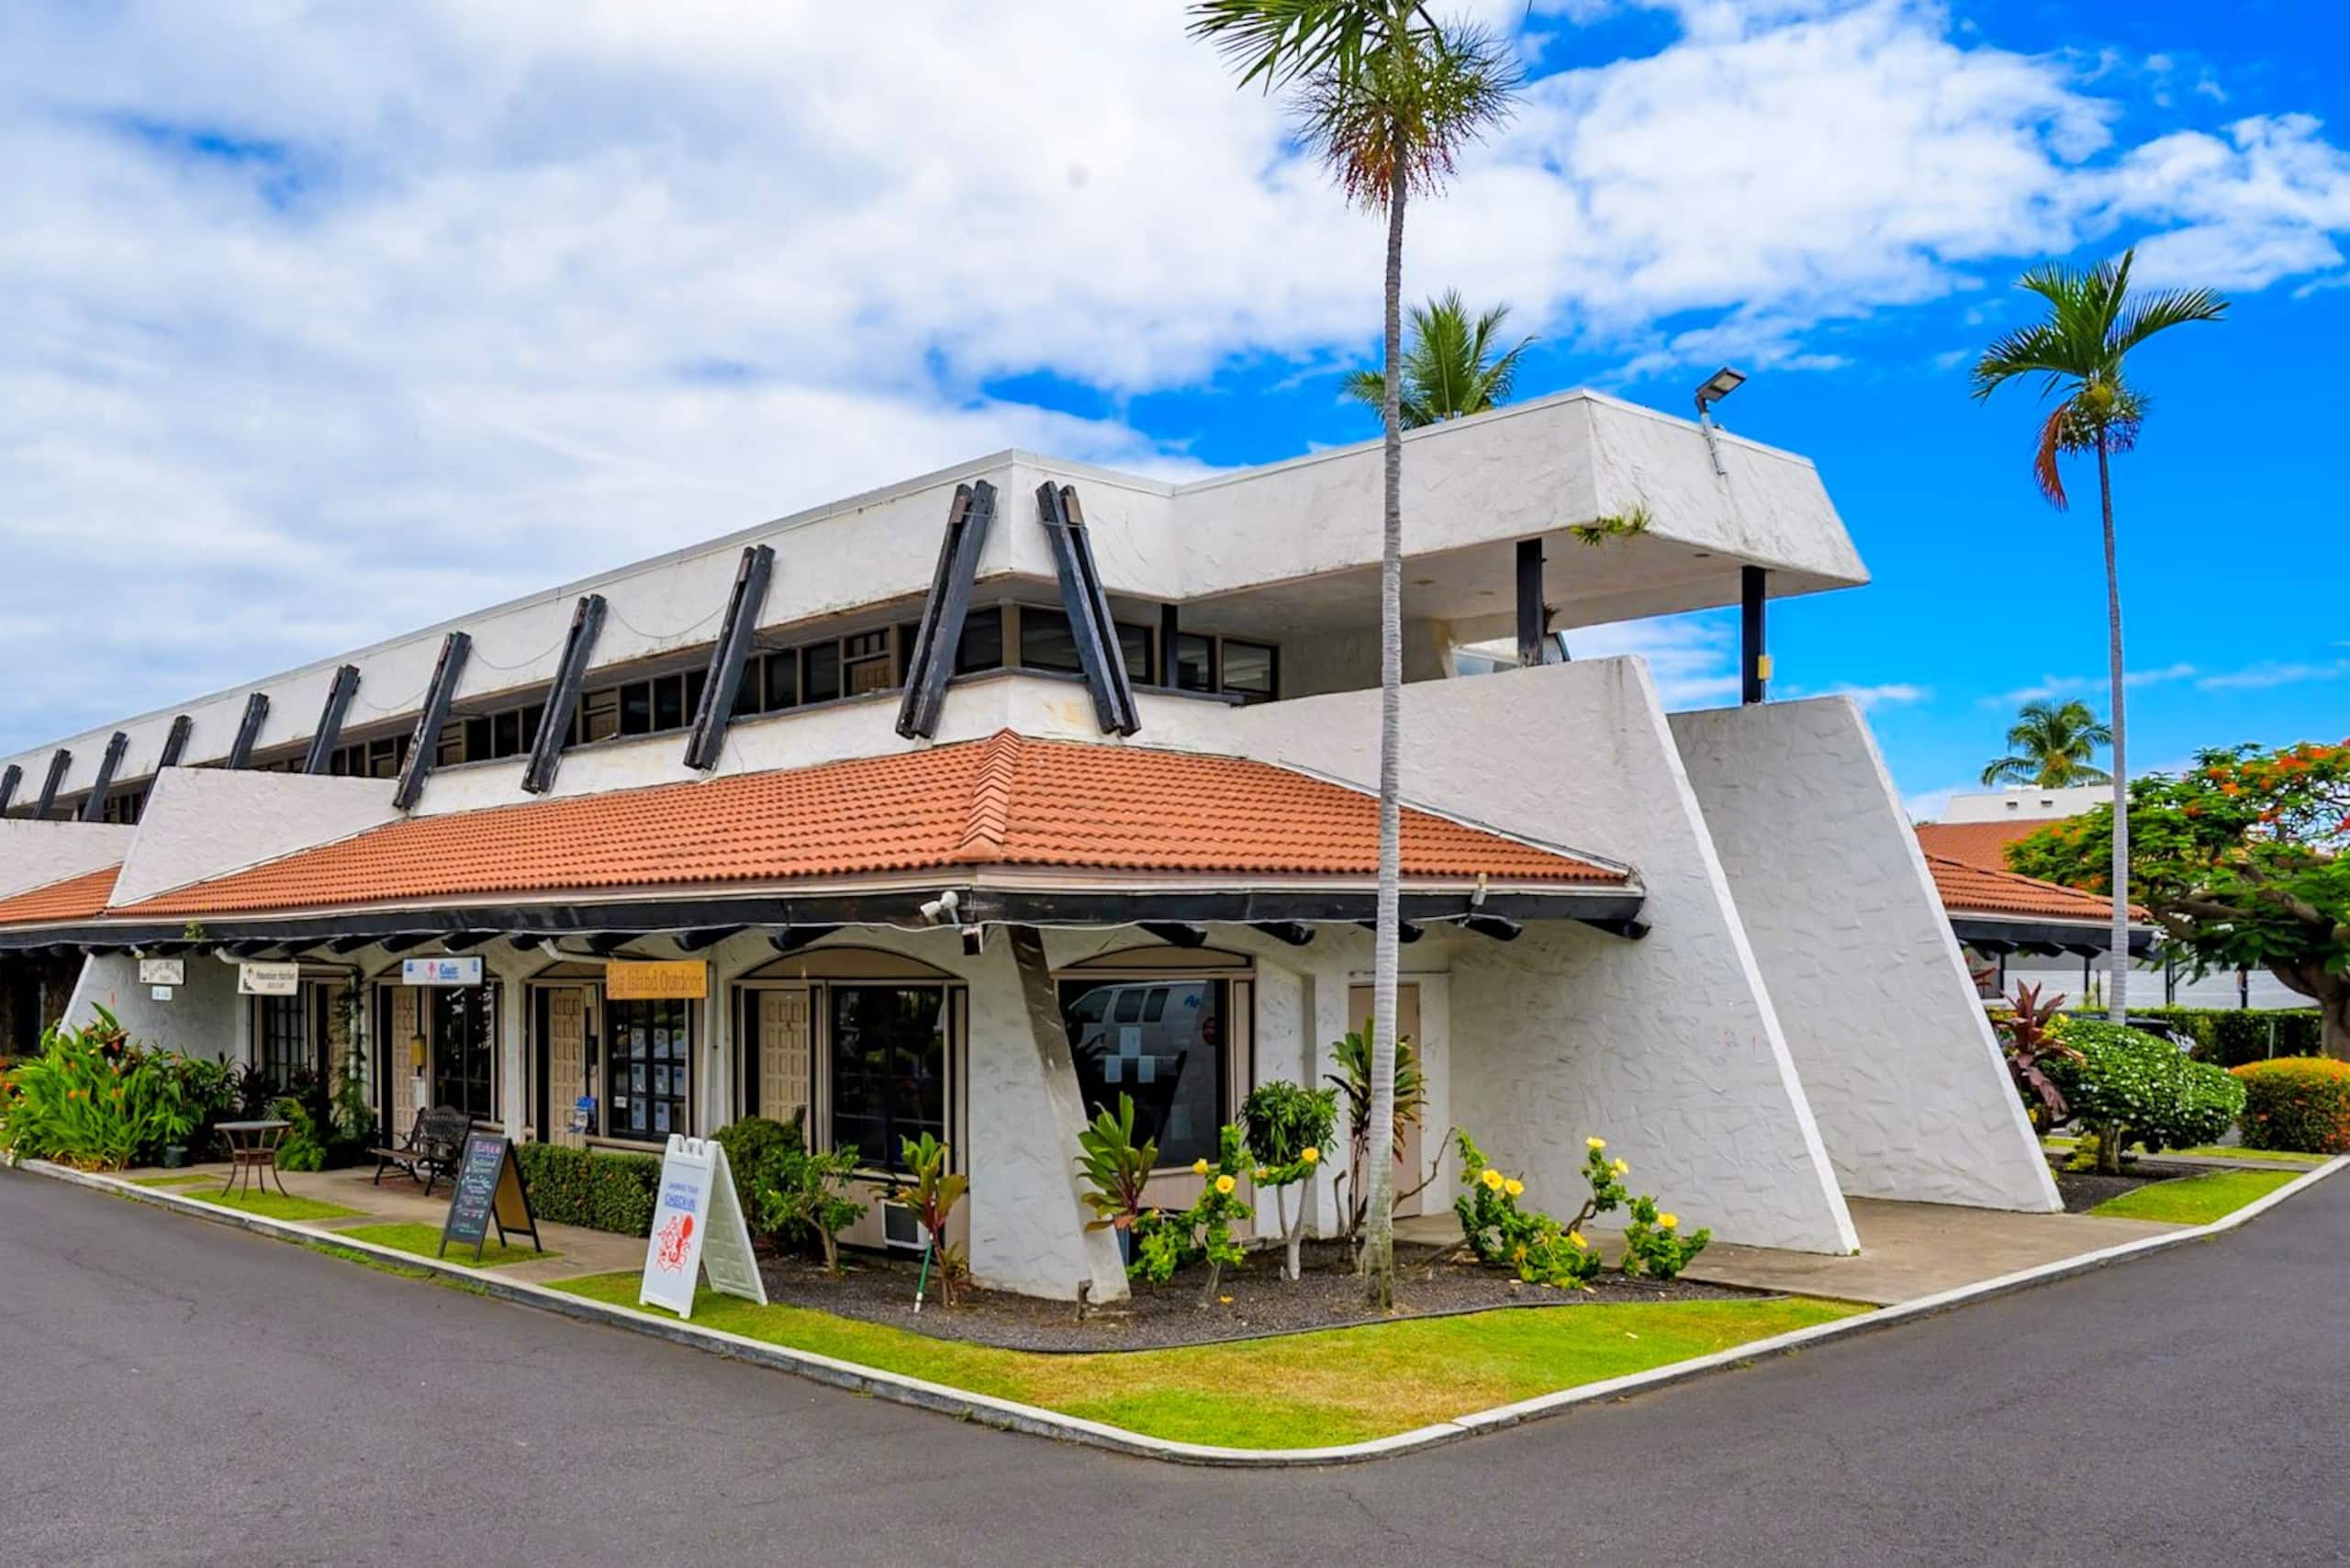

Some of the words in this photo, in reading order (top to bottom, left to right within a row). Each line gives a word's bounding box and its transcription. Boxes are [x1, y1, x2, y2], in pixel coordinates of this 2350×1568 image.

[609, 969, 625, 994] Big
[627, 969, 658, 991] Island
[660, 968, 704, 992] Outdoor
